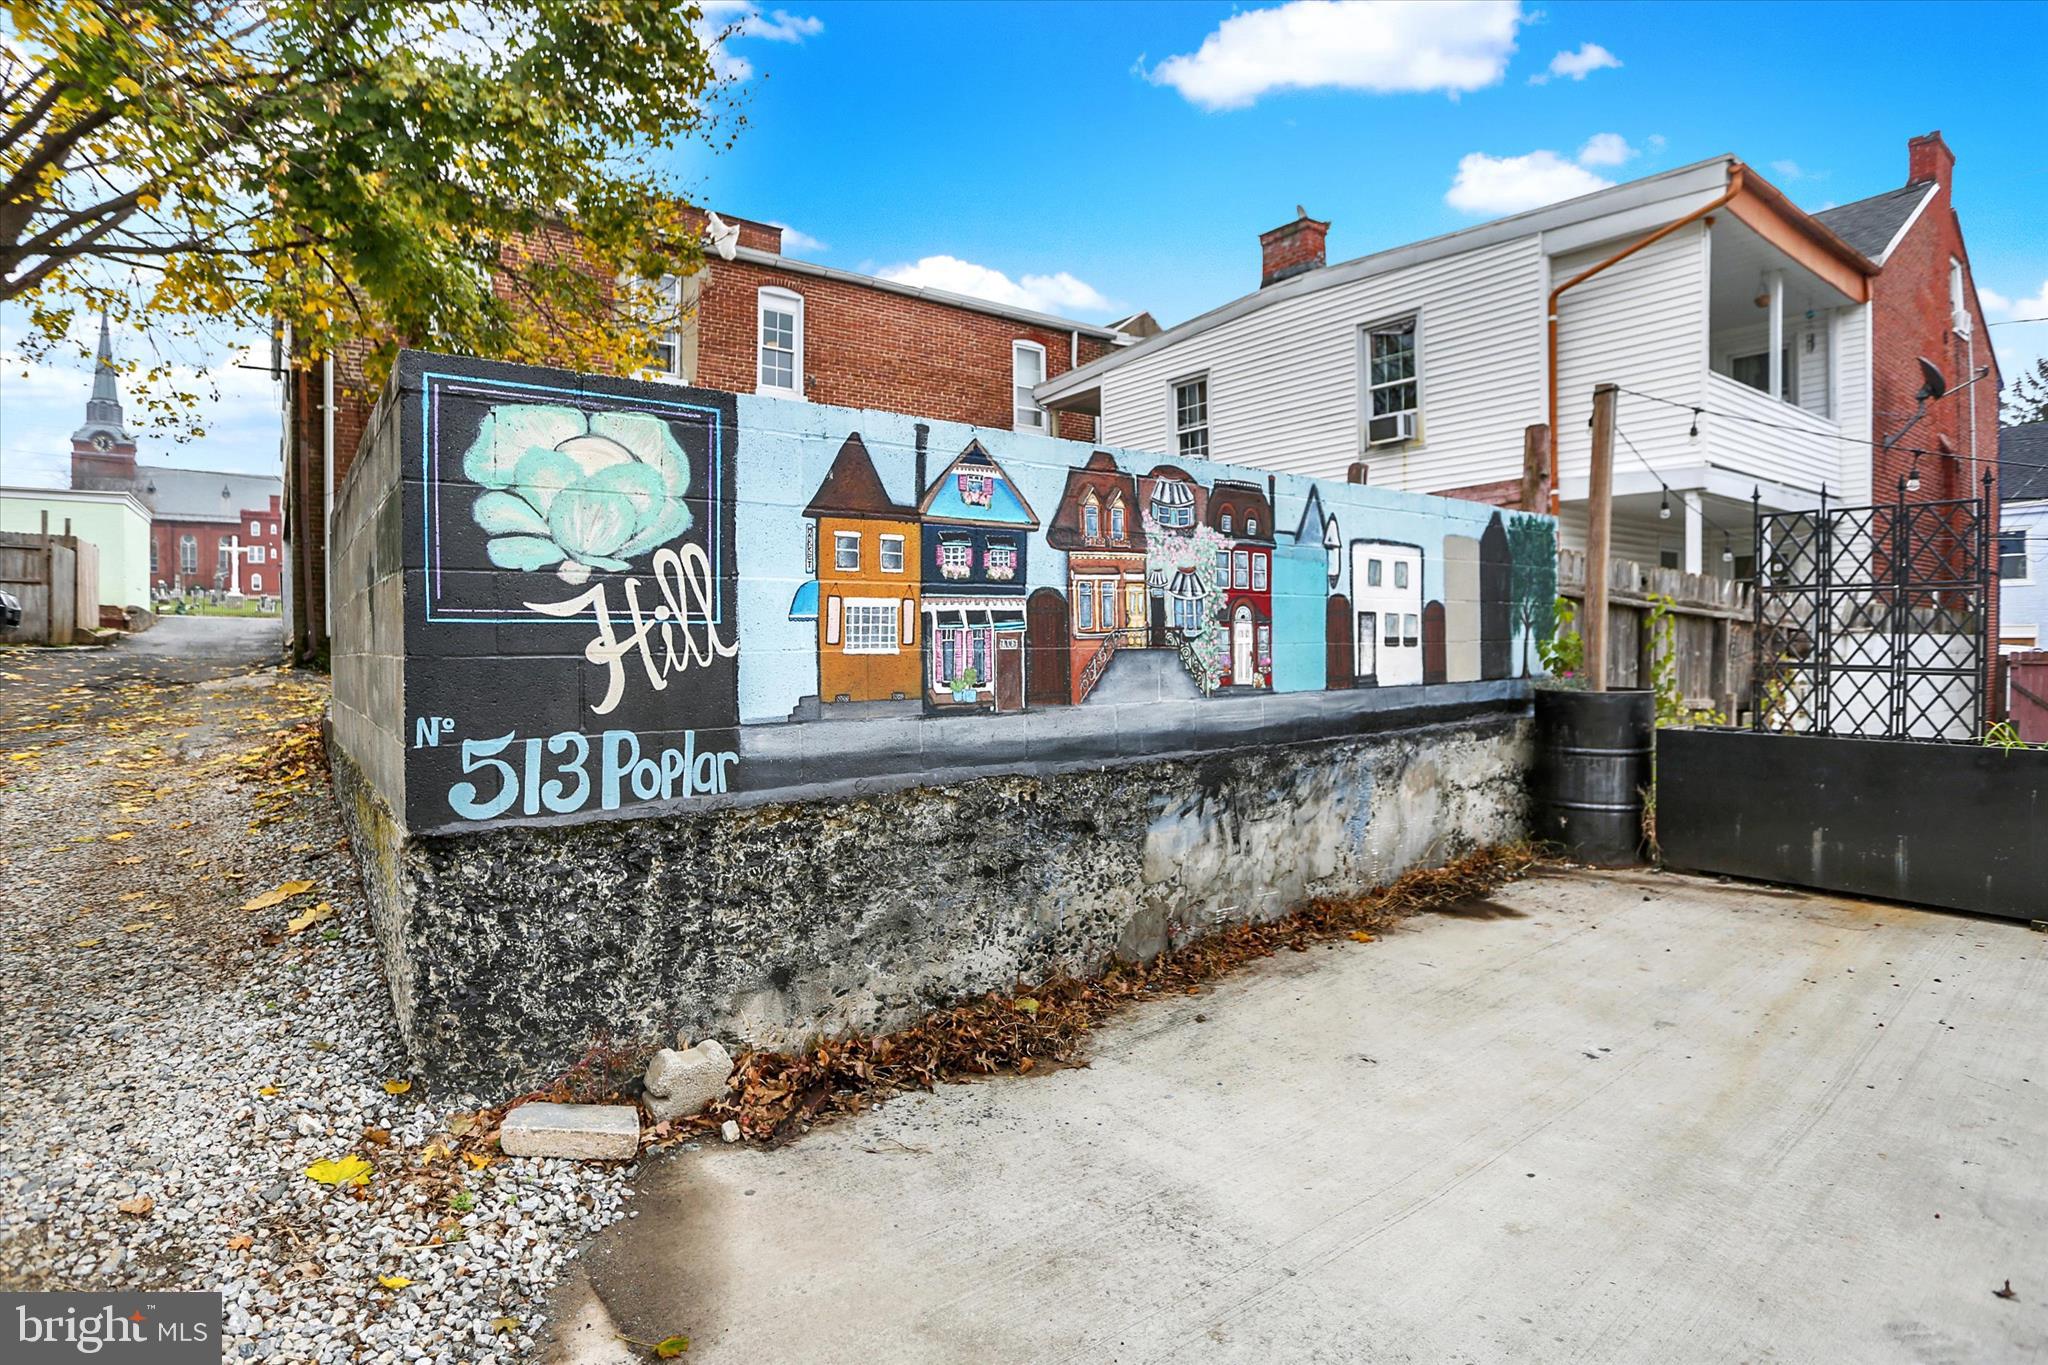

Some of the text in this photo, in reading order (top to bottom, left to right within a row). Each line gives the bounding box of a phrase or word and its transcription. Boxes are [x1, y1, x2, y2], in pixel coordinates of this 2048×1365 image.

[523, 543, 738, 714] Hill
[448, 730, 590, 820] 513
[602, 730, 739, 810] Poplar
